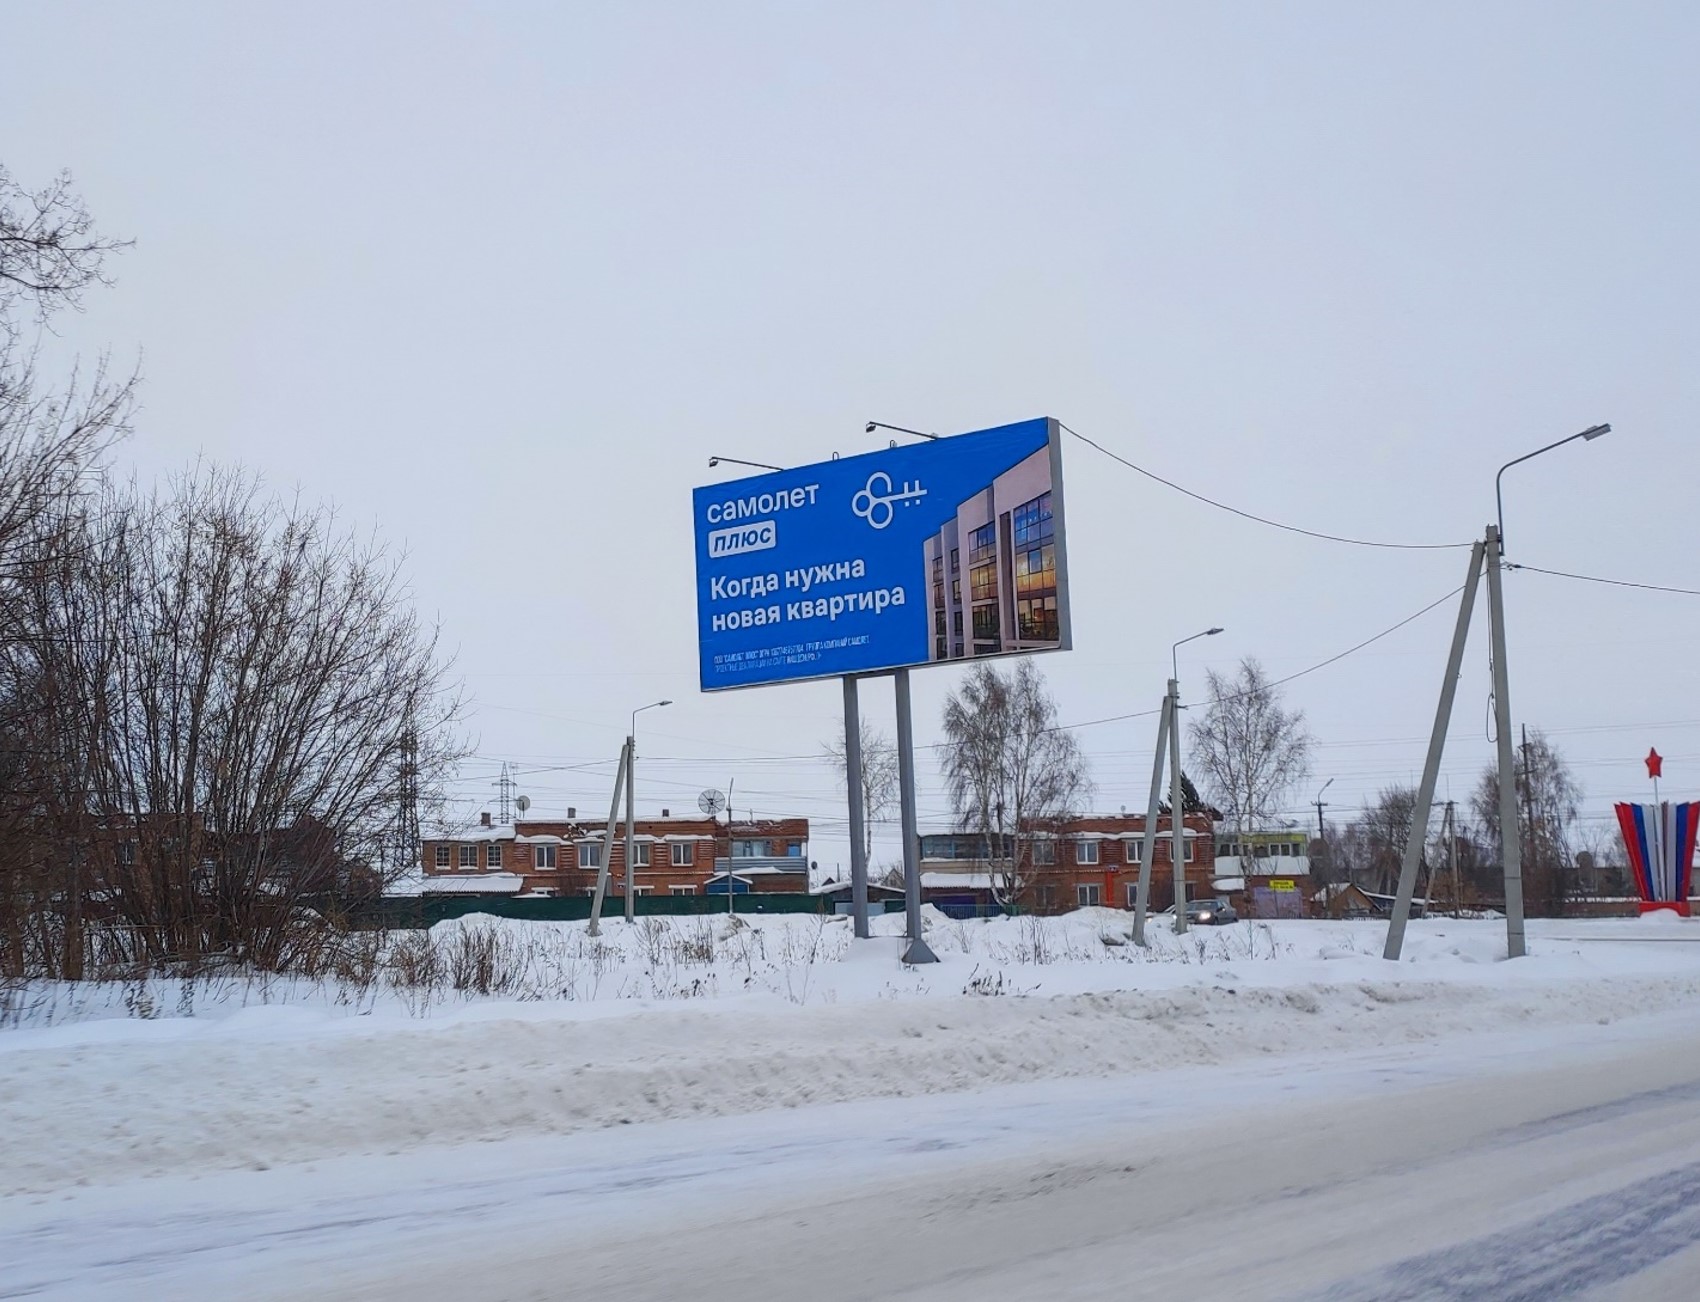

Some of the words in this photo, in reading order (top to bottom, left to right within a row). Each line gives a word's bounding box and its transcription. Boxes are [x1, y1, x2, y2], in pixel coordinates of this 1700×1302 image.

[706, 484, 818, 524] самолет
[713, 526, 773, 553] плюс
[711, 572, 779, 600] Когда
[785, 558, 866, 591] нужна
[712, 604, 781, 632] новая
[786, 585, 905, 621] квартира
